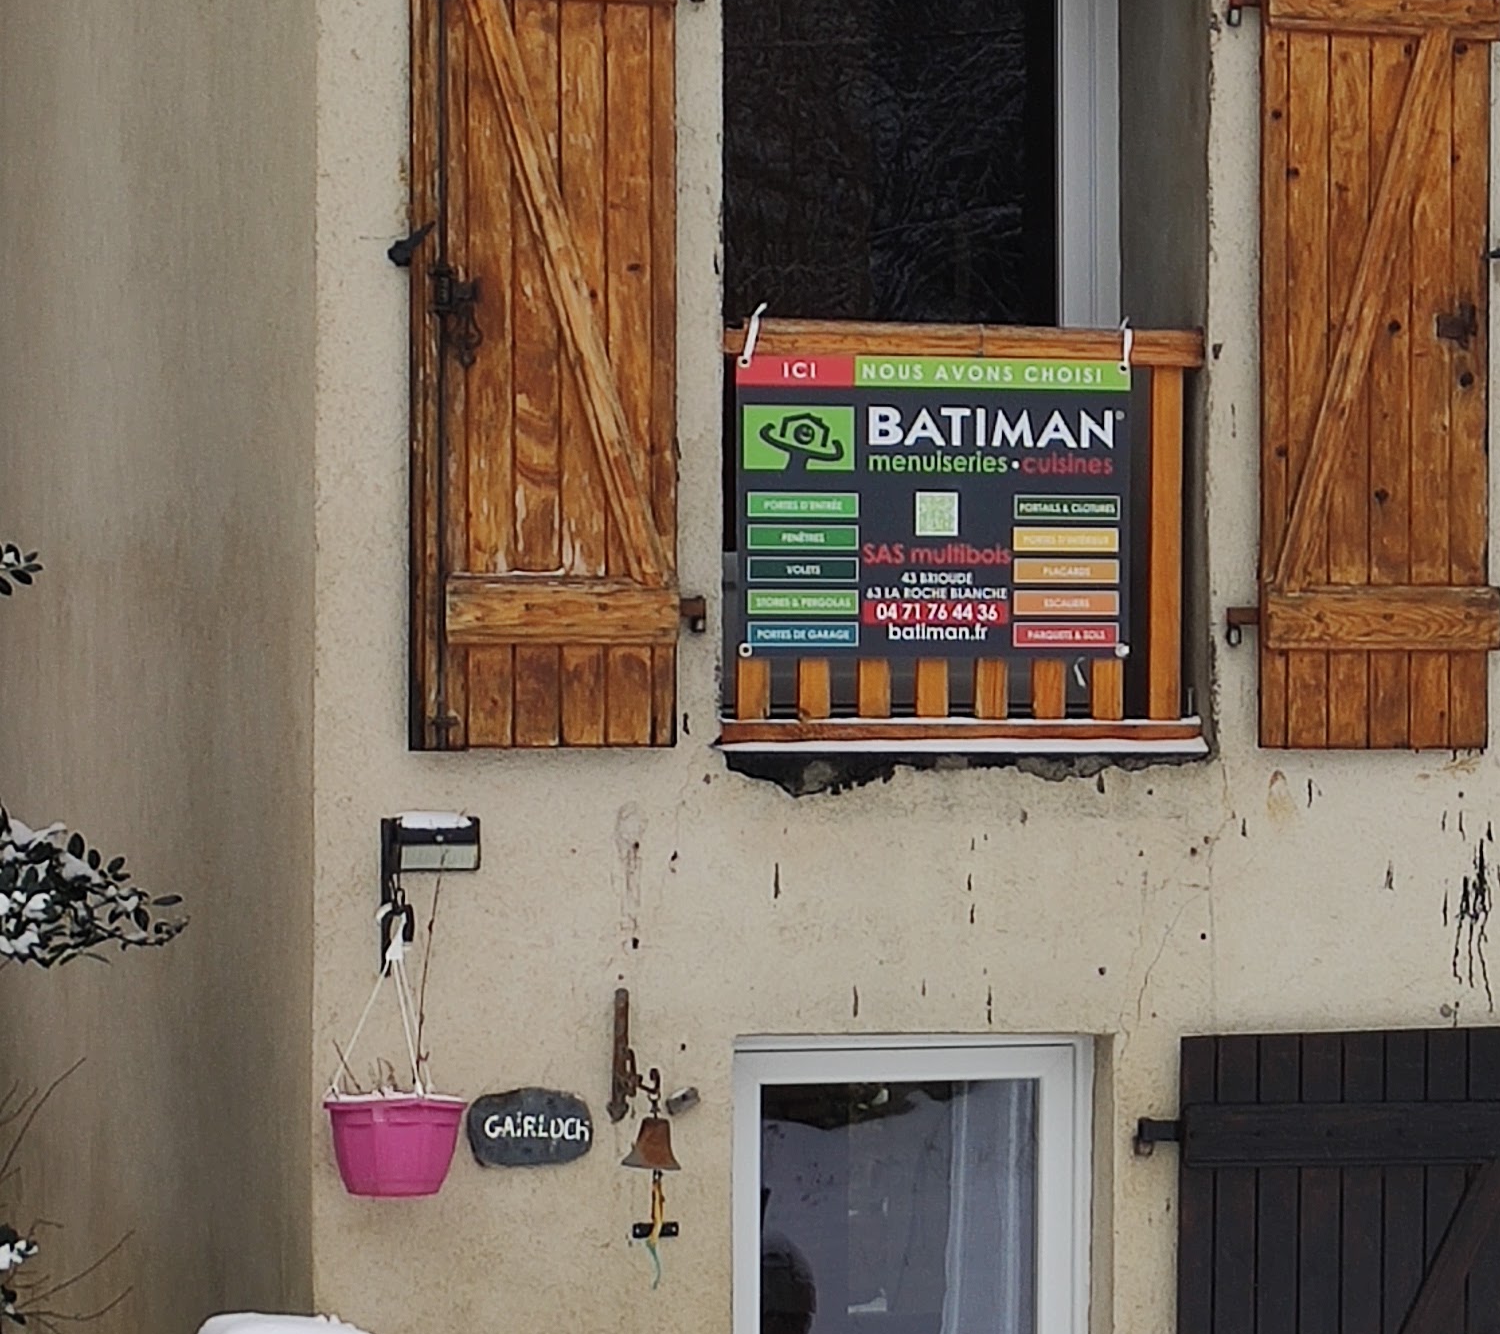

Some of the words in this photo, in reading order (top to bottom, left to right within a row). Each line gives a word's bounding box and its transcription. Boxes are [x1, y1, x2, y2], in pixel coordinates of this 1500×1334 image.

[783, 362, 816, 378] ICI
[862, 363, 923, 380] NOUS
[934, 365, 1013, 382] AVONS
[1024, 366, 1101, 383] CHOISI
[862, 543, 905, 564] SAS
[910, 543, 1011, 564] multibois
[786, 565, 821, 575] VOLETS
[901, 572, 917, 584] 43
[920, 572, 973, 585] BRIOUDE
[866, 587, 881, 599] 63
[884, 587, 900, 599] LA
[904, 587, 947, 599] ROCHE
[950, 587, 1007, 599] BLANCHE
[876, 602, 898, 620] 04
[902, 603, 921, 620] 71
[927, 603, 948, 620] 76
[951, 603, 973, 620] 44
[977, 603, 998, 621] 36
[756, 629, 792, 639] PORTES
[793, 629, 806, 639] DE
[807, 629, 850, 640] GARAGE
[888, 622, 988, 640] batiman.fr
[1027, 629, 1073, 640] PARQUETS
[1074, 630, 1081, 640] &
[1083, 630, 1106, 640] SOLS
